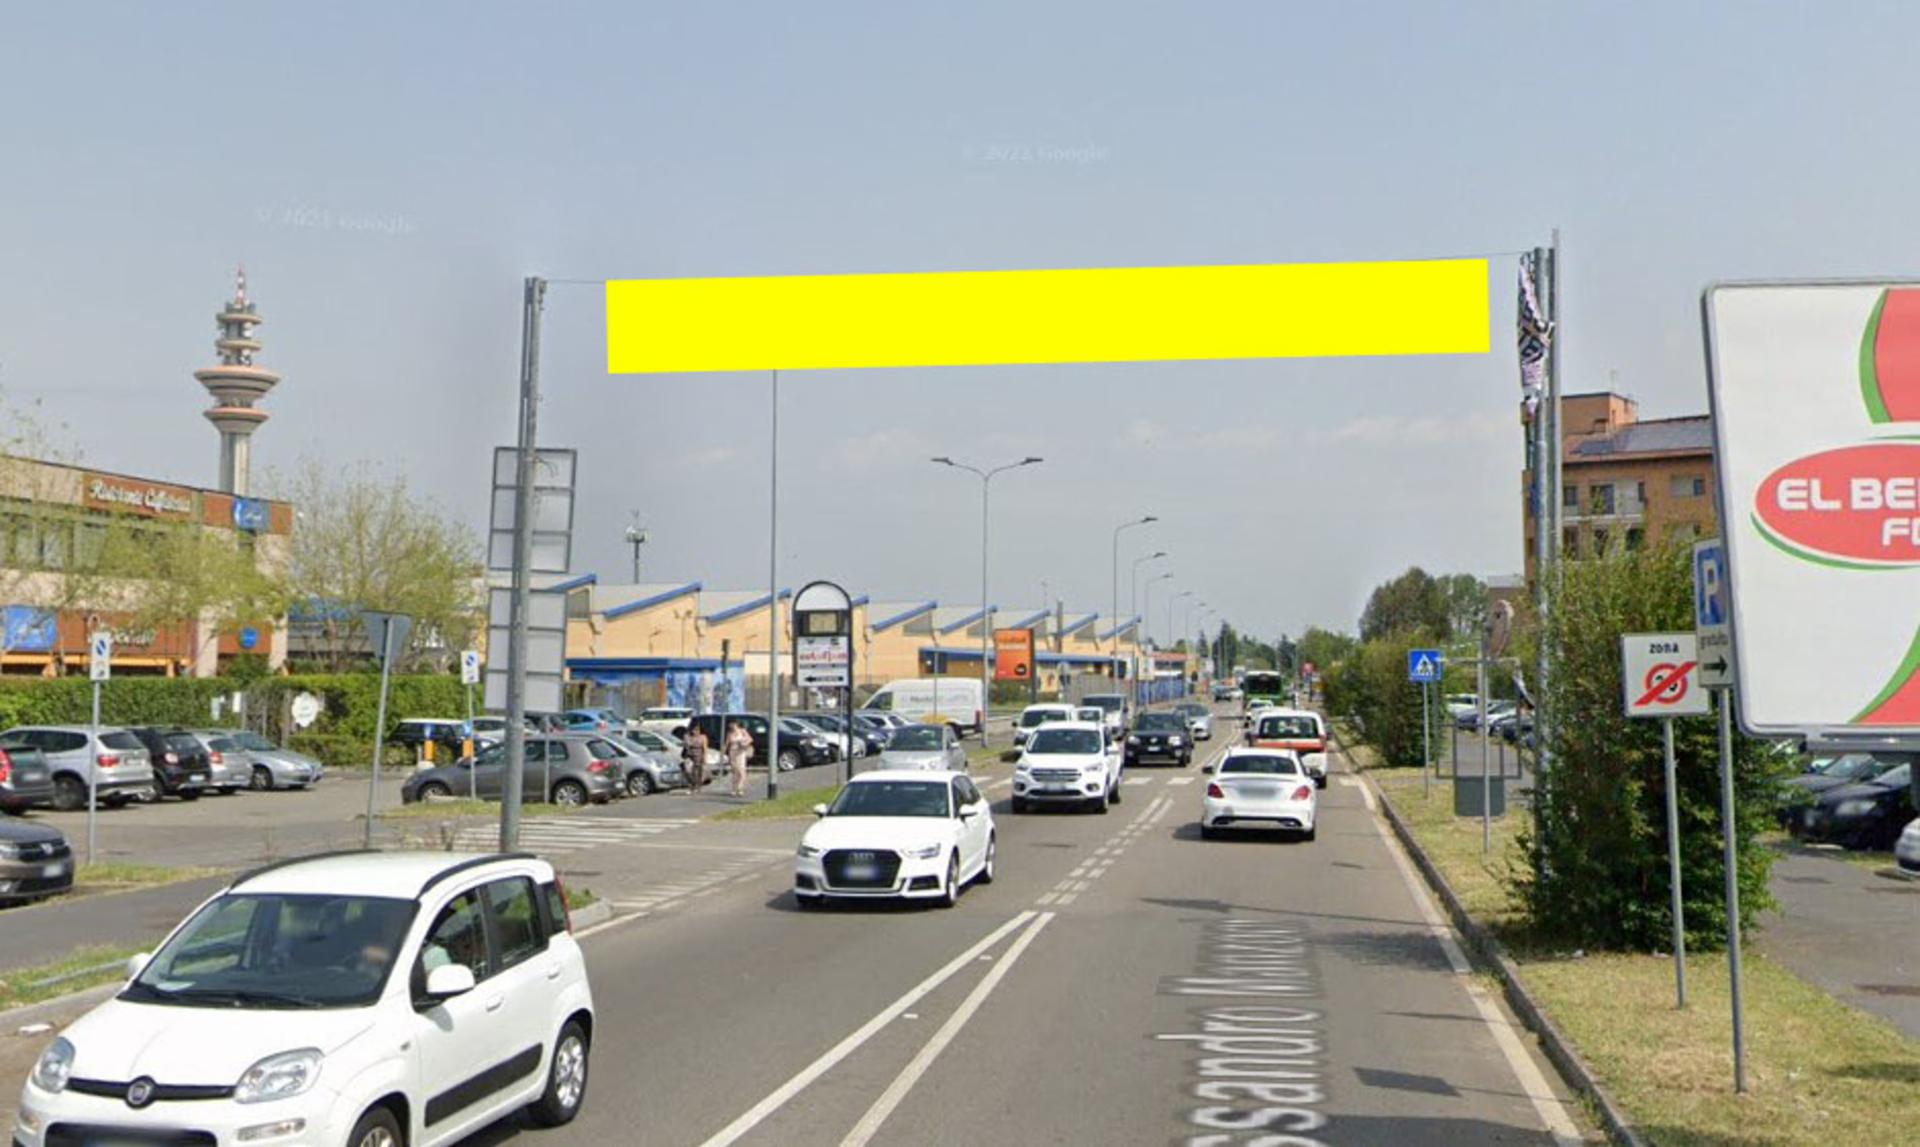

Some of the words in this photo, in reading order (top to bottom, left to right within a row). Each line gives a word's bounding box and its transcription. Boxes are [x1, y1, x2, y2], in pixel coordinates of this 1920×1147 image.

[1776, 478, 1842, 511] EL
[1850, 477, 1920, 511] BE
[1649, 643, 1679, 654] zona
